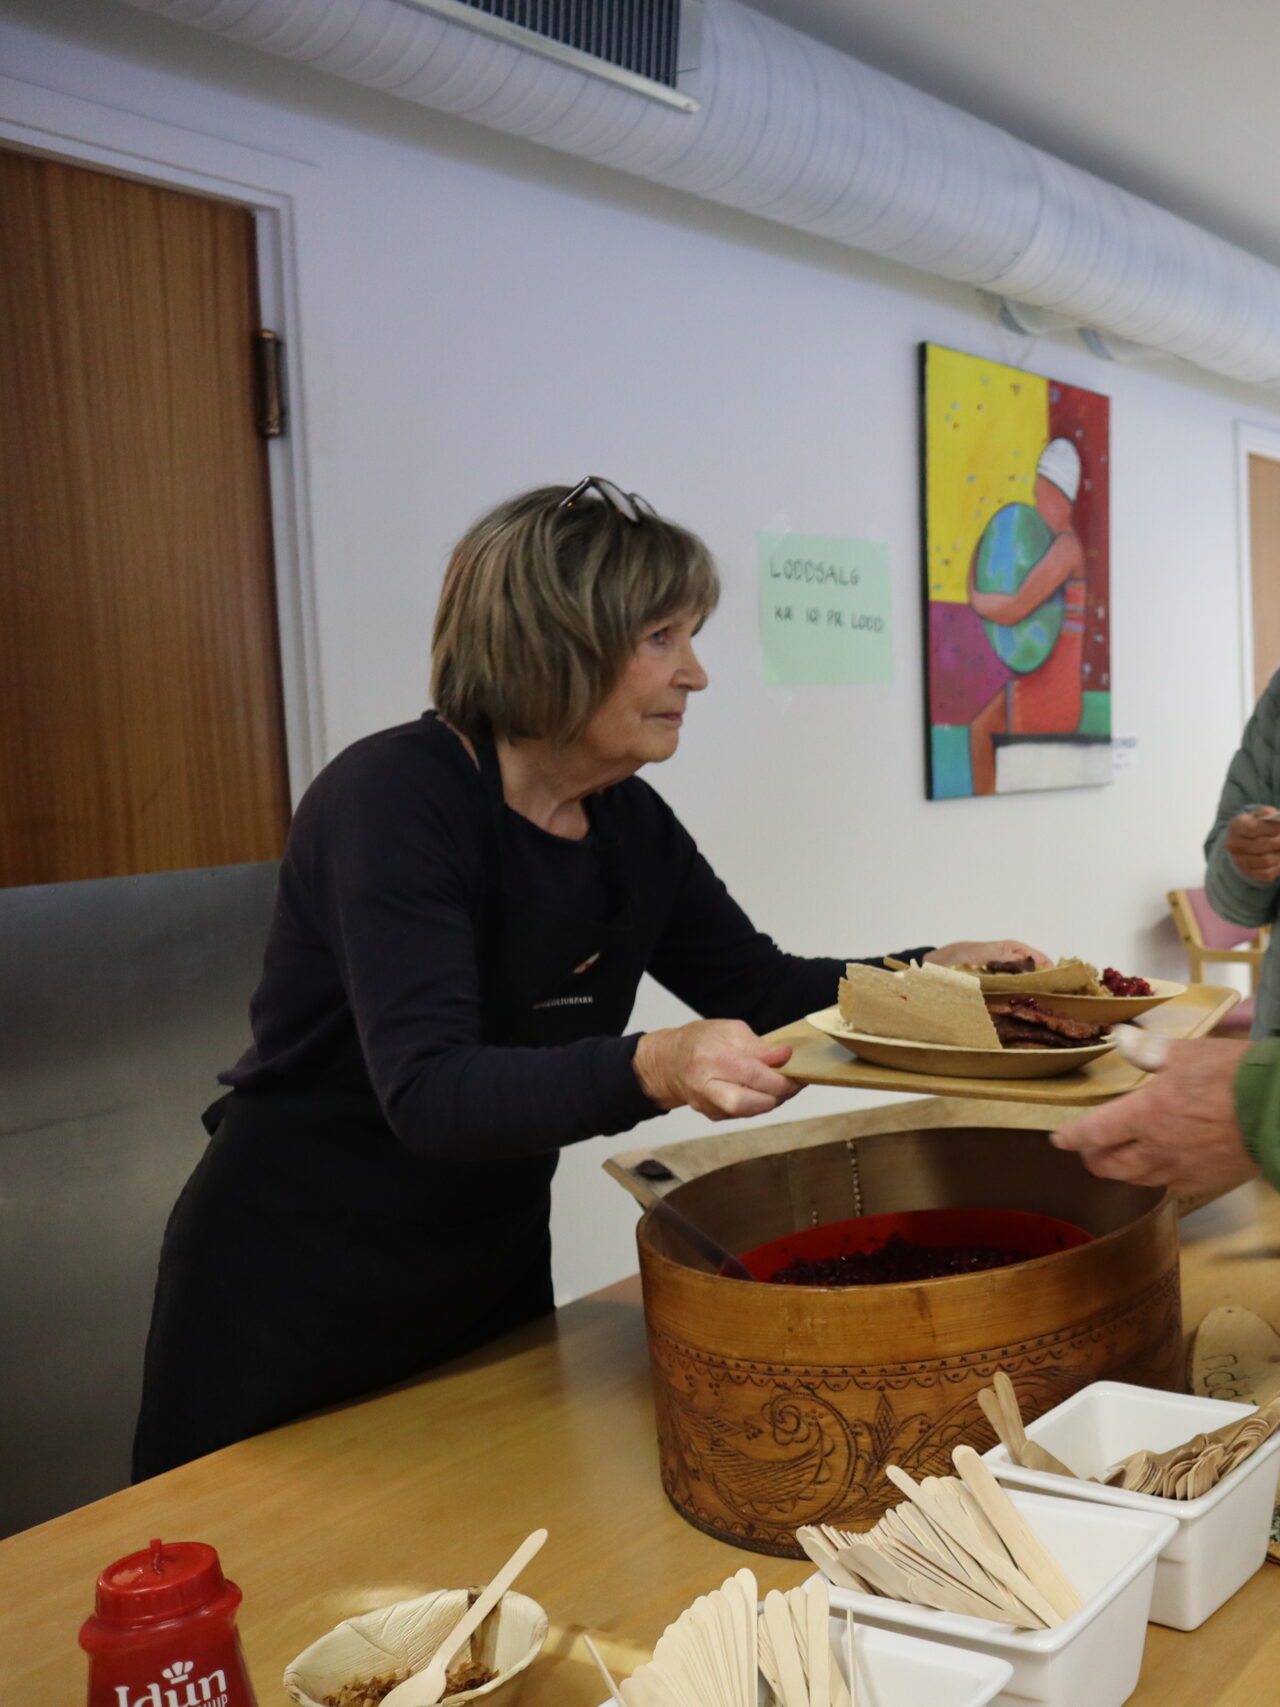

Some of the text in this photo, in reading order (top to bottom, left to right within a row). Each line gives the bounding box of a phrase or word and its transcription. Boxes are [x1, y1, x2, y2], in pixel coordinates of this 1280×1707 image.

[769, 555, 860, 586] LODDSALG
[774, 605, 884, 633] KR 10 PR LODD
[114, 1669, 228, 1707] Idun
